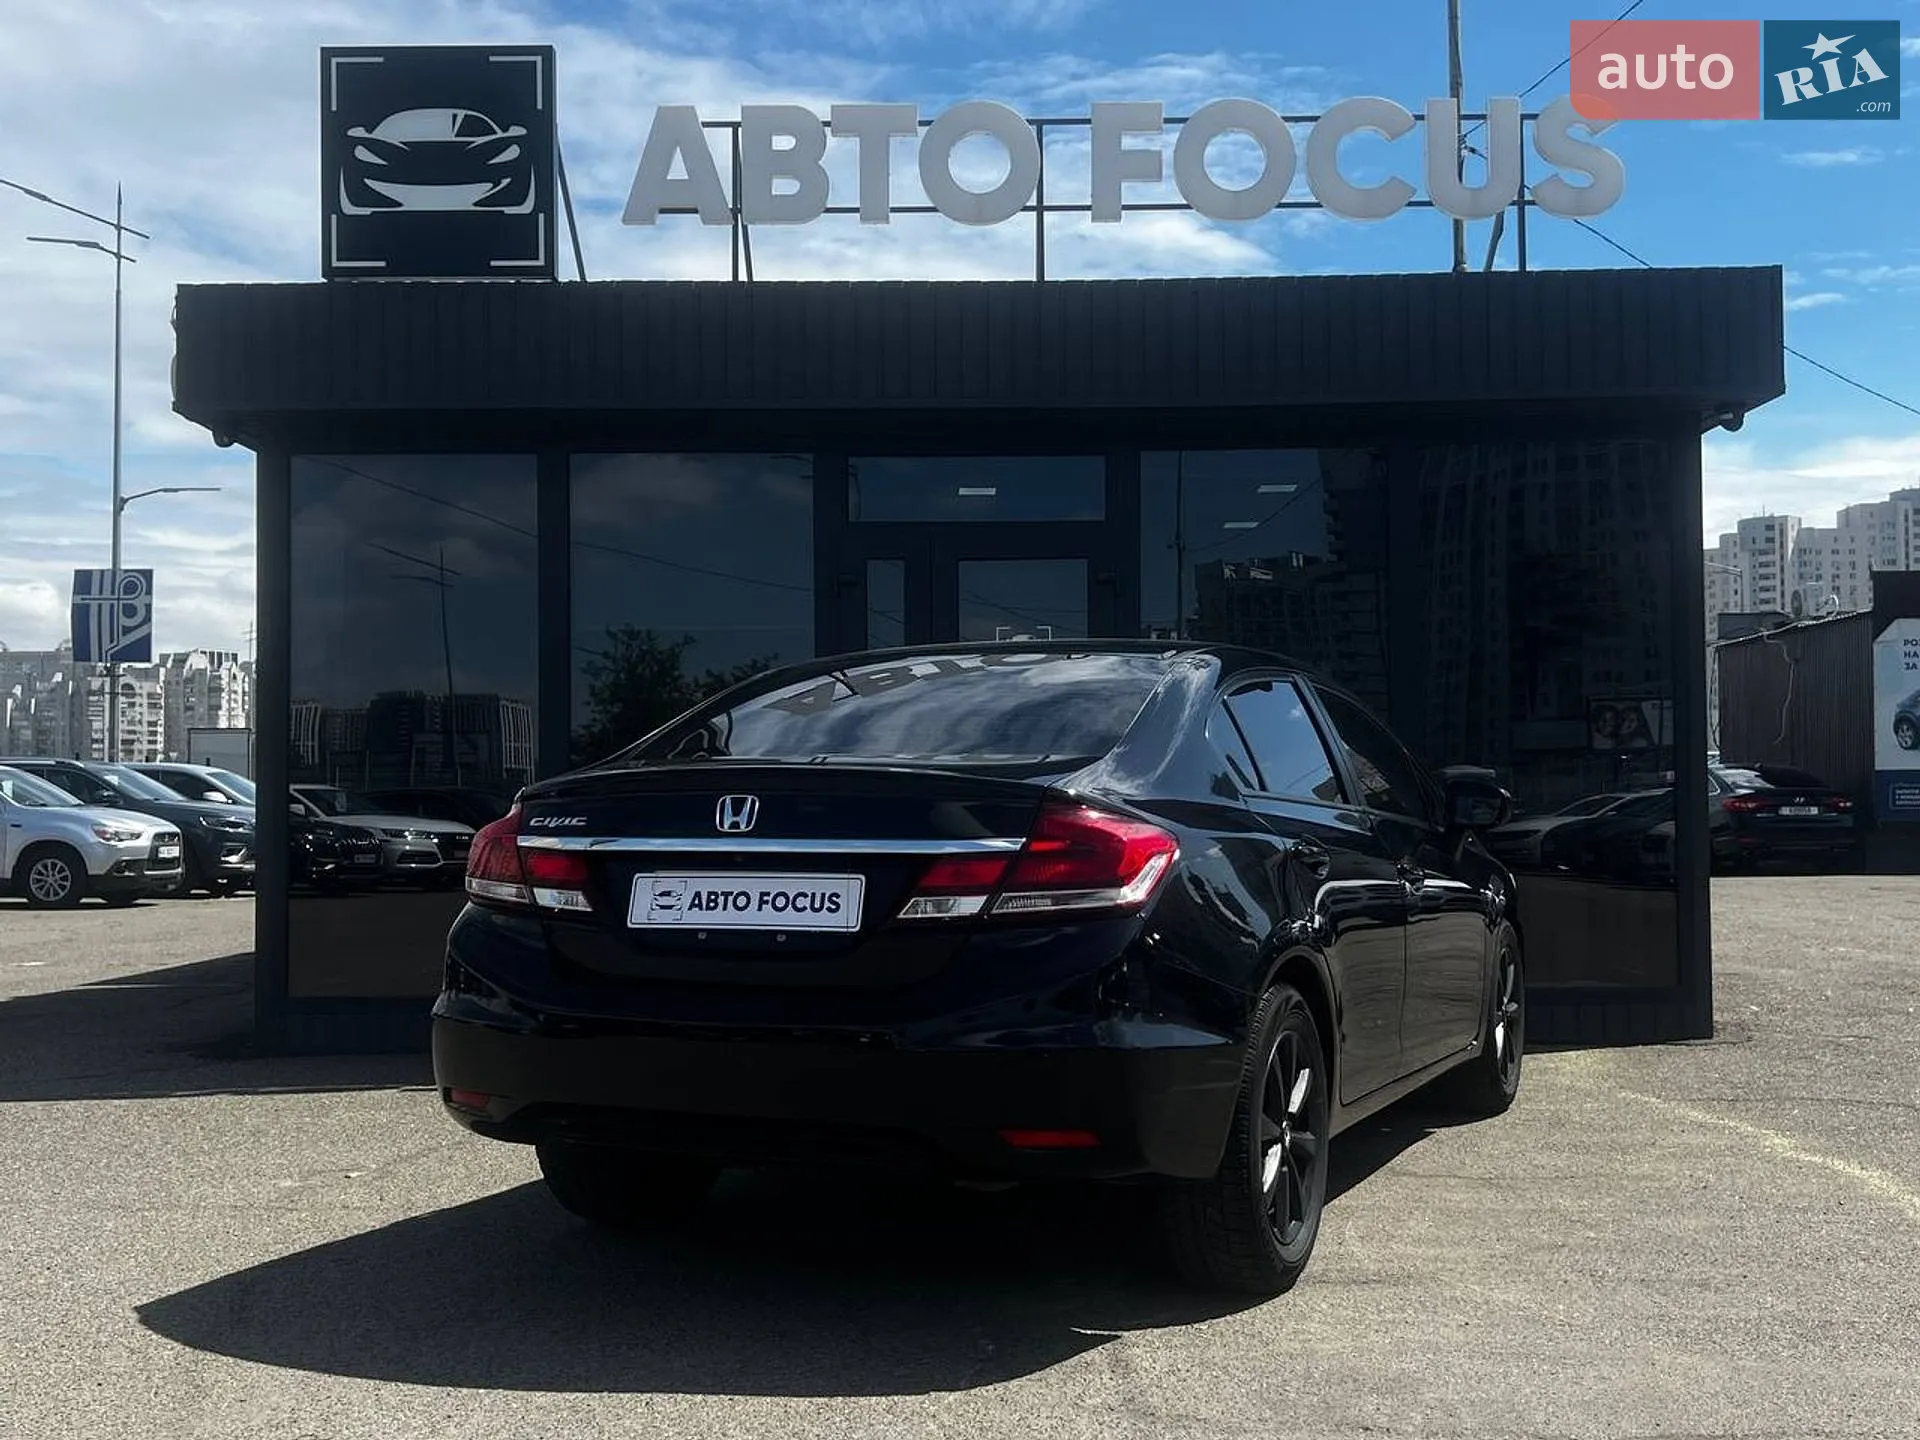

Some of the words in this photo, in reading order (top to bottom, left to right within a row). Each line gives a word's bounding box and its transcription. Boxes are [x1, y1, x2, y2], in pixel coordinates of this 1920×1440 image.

[621, 99, 1042, 226] АВТО
[1090, 95, 1627, 221] FOCUS
[1903, 638, 1920, 647] РО
[529, 816, 588, 828] CIVIC
[687, 890, 751, 913] АВТО
[756, 891, 842, 914] FOCUS
